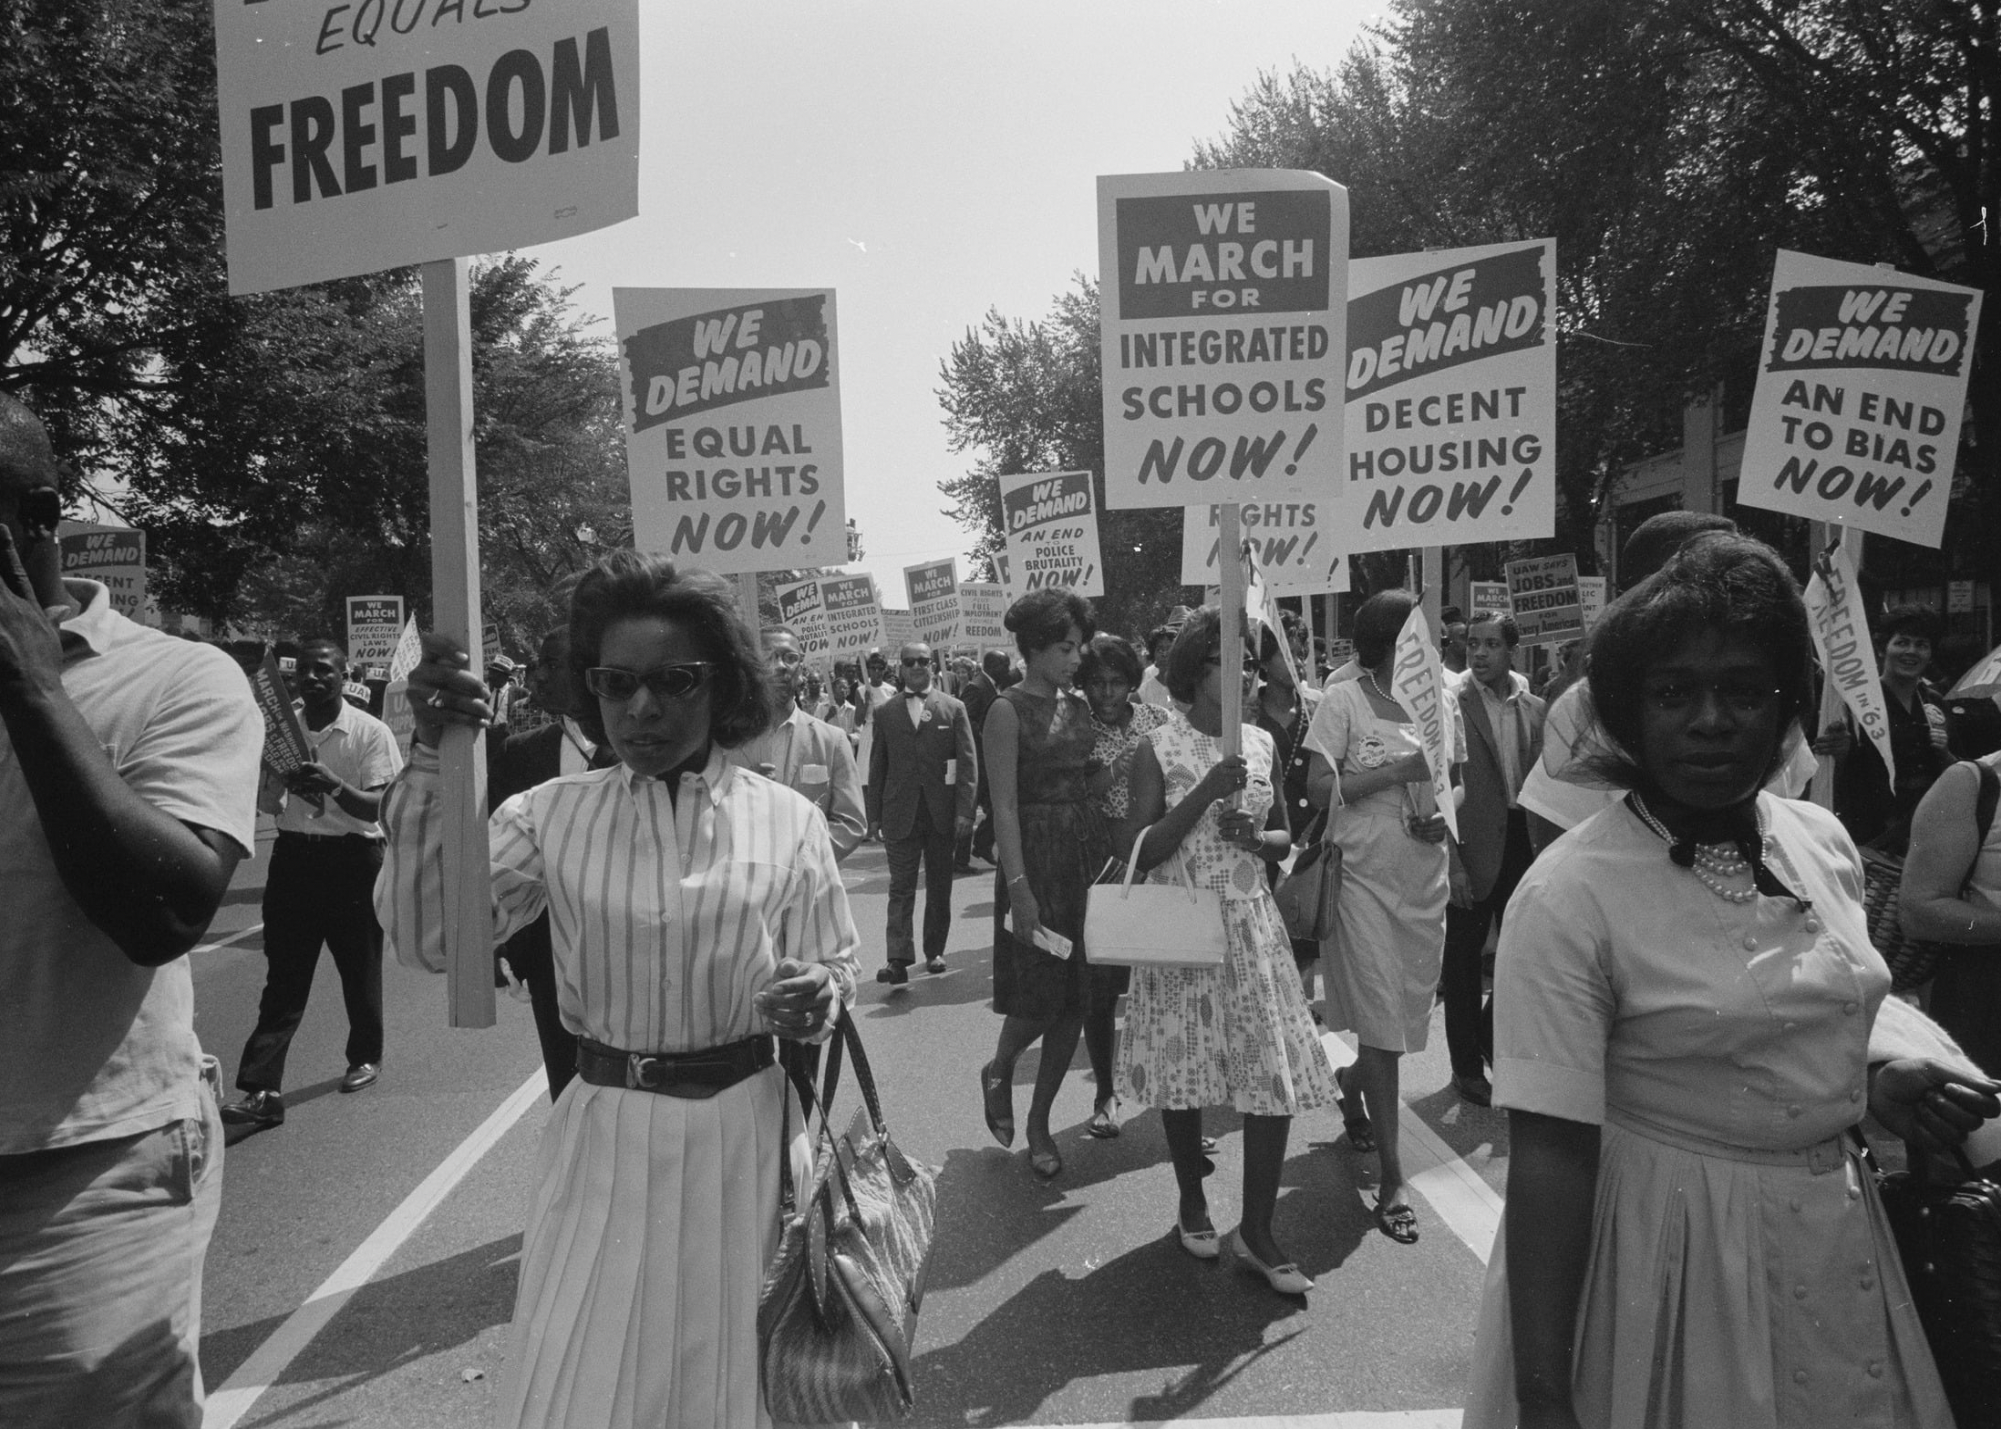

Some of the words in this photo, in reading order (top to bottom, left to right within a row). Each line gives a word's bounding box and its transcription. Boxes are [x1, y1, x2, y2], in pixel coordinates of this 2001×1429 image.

[250, 25, 620, 211] FREEDOM
[1193, 202, 1256, 235] WE
[1135, 239, 1314, 285] MARCH
[1192, 288, 1261, 309] FOR
[1399, 268, 1476, 327] WE
[1838, 290, 1912, 323] WE
[693, 309, 764, 359] WE
[1346, 295, 1539, 390] DEMAND
[1781, 326, 1960, 363] DEMAND
[1120, 325, 1329, 369] INTEGRATED
[645, 339, 822, 416] DEMAND
[1121, 377, 1326, 421] SCHOOLS
[1365, 386, 1527, 433] DECENT
[1781, 379, 1845, 416] AN
[1859, 392, 1946, 436] END
[666, 424, 812, 460] EQUAL
[1781, 415, 1833, 451] TO
[1845, 428, 1937, 474] BIAS
[1137, 423, 1318, 485] NOW!
[1350, 434, 1542, 481] HOUSING
[666, 464, 819, 502] RIGHTS
[1032, 479, 1063, 502] WE
[1773, 455, 1933, 517] NOW!
[1363, 467, 1533, 530] NOW!
[1013, 491, 1087, 529] DEMAND
[1208, 503, 1316, 527] RGHTS
[670, 499, 826, 555] NOW!
[1020, 530, 1046, 542] AN
[1051, 528, 1084, 539] END
[86, 533, 116, 549] WE
[1036, 545, 1074, 558] POLICE
[66, 546, 138, 568] DEMAND
[1025, 557, 1083, 571] BRUTALITY
[1513, 564, 1539, 574] UAW
[1543, 560, 1568, 570] SAYS
[914, 576, 951, 594] MARCH
[925, 569, 937, 579] WE
[1026, 563, 1094, 590] NOW!
[1513, 574, 1555, 593] JOBS
[1557, 574, 1574, 586] and
[796, 584, 815, 600] WE
[827, 588, 869, 603] MARCH
[838, 581, 854, 590] WE
[980, 589, 1003, 597] RIGHTS
[913, 603, 935, 616] FIRST
[936, 598, 958, 611] CLASS
[1515, 590, 1578, 612] FREEDOM
[354, 609, 395, 618] MARCH
[792, 616, 807, 626] AN
[810, 614, 823, 622] EN
[827, 606, 877, 622] INTEGRATED
[913, 609, 960, 628] CITIZENSHIP
[802, 623, 826, 634] POLICE
[830, 618, 879, 634] SCHOOLS
[923, 622, 958, 643] NOW!
[966, 626, 1001, 637] REEDOM
[1542, 619, 1580, 631] American
[837, 629, 879, 648] NOW!
[355, 647, 397, 658] NOW!
[257, 668, 281, 714] MARCH
[1394, 632, 1440, 751] FREEDOM
[1856, 693, 1869, 708] IN
[1862, 707, 1885, 741] '63
